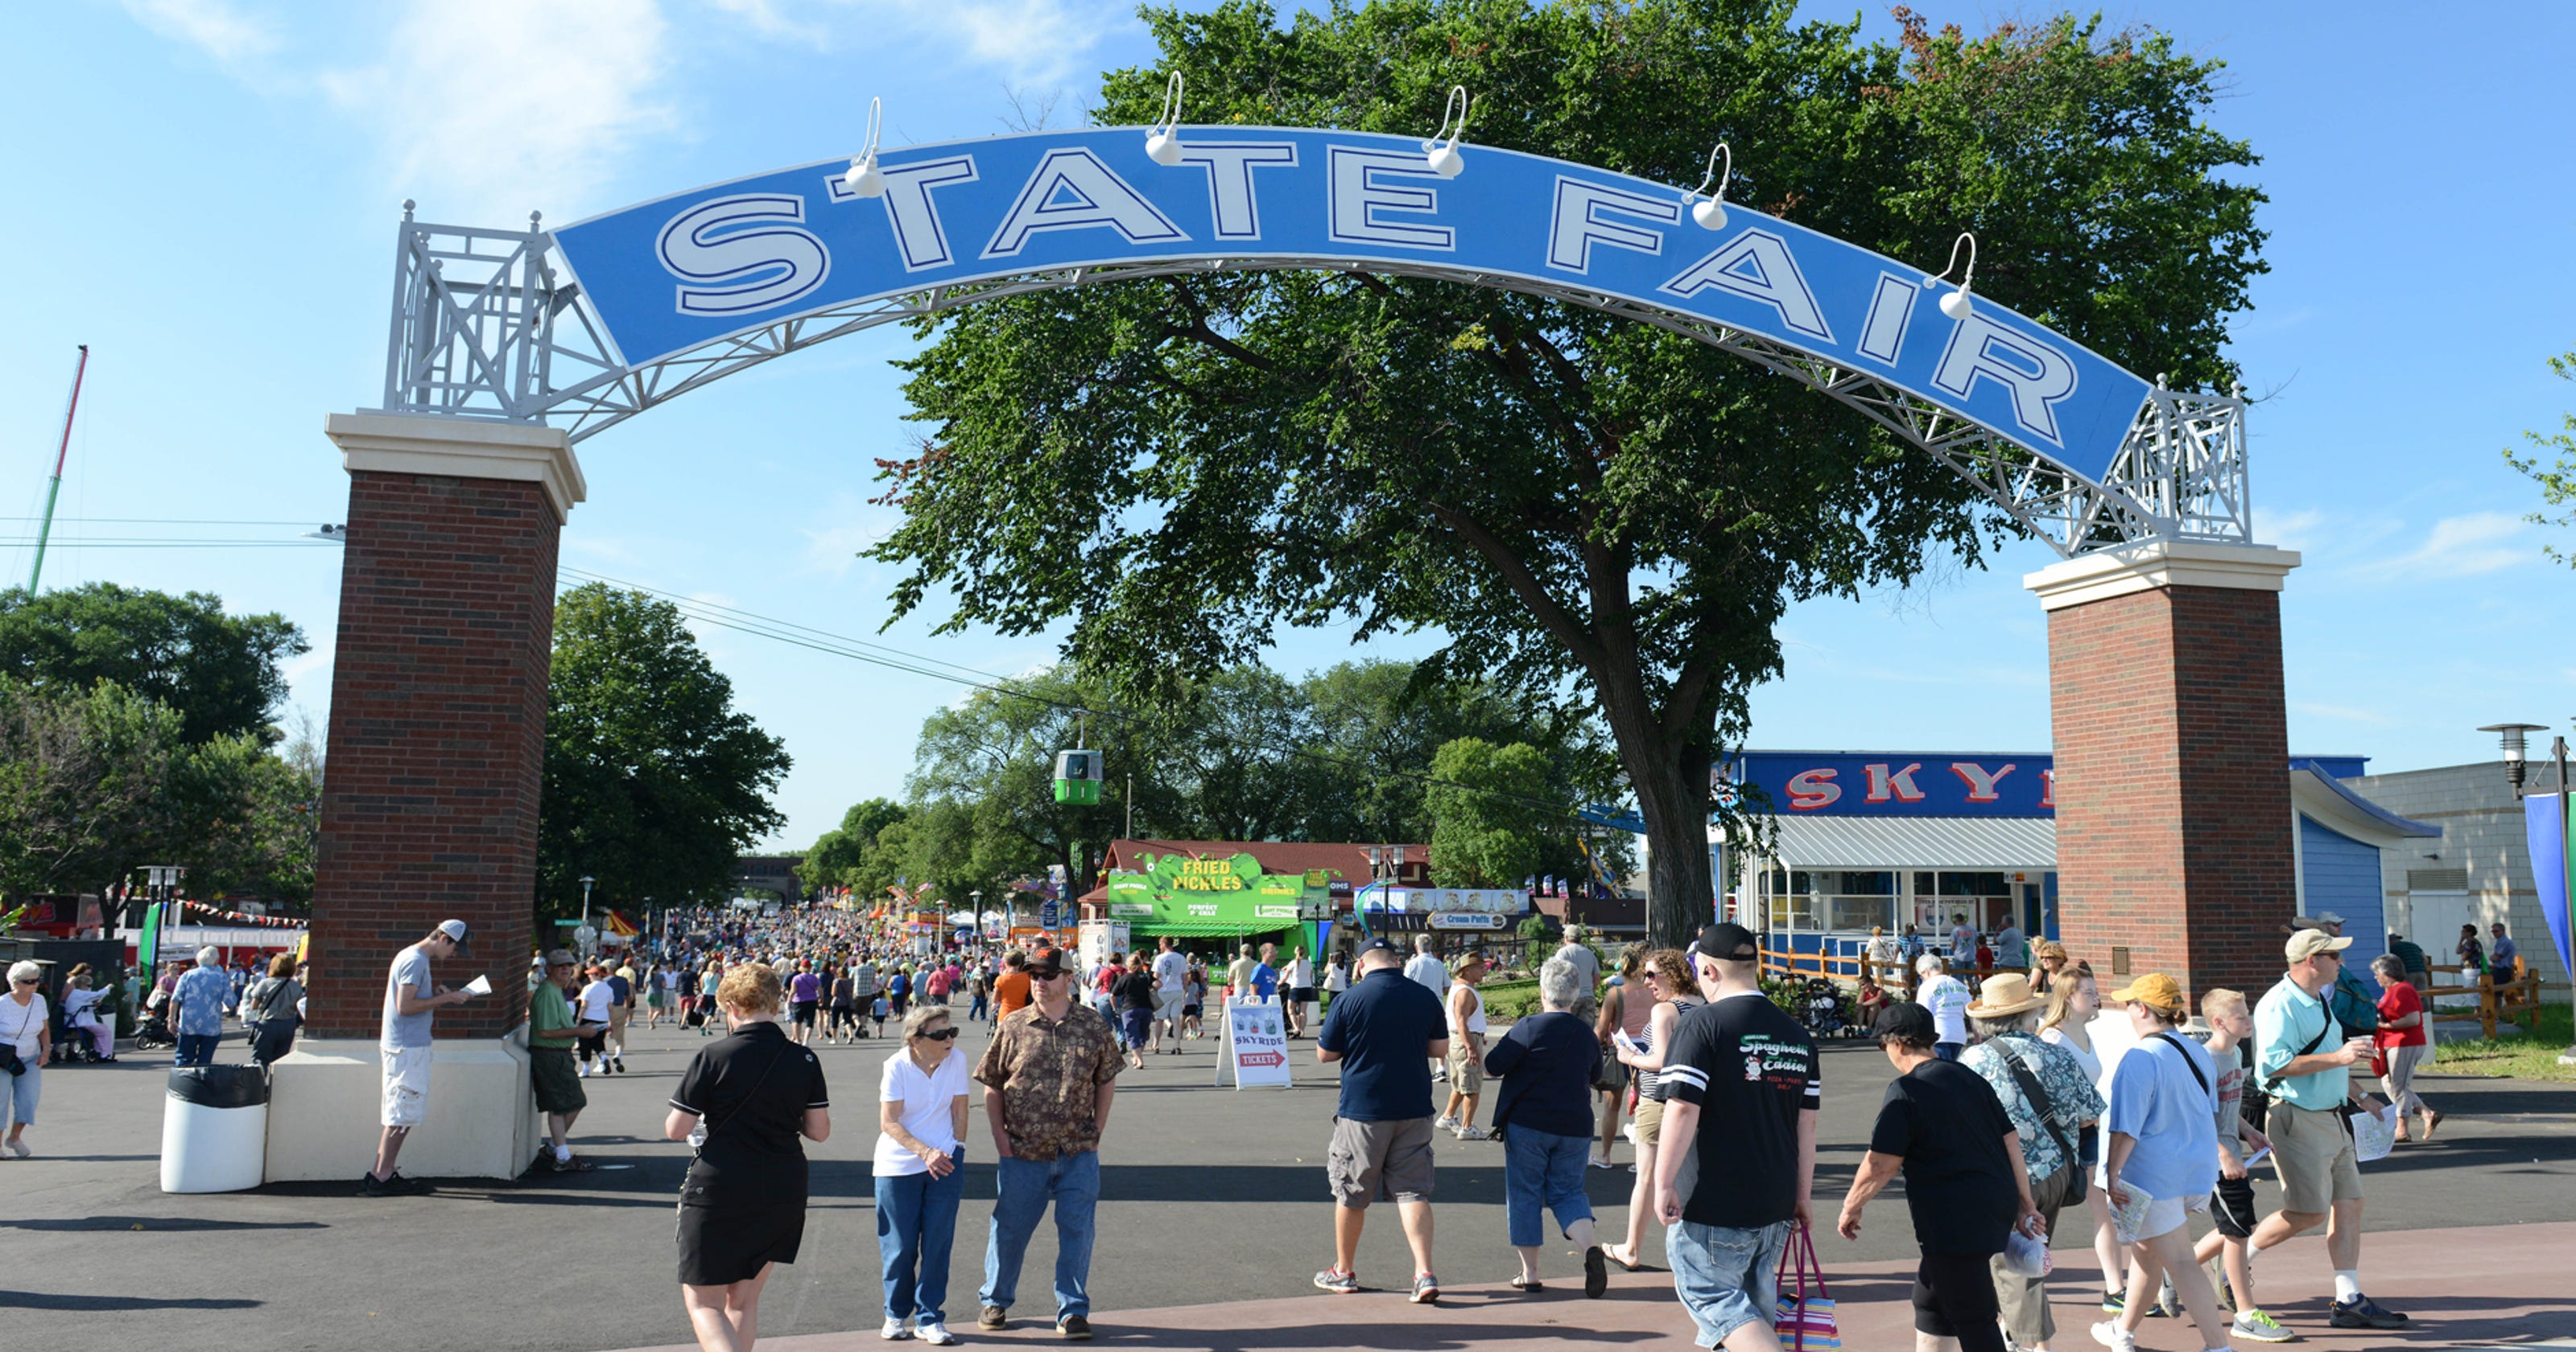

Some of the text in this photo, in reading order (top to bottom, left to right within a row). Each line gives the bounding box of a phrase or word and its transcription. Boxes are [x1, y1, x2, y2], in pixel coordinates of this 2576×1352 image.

[655, 140, 2079, 449] STATE FAIR
[1785, 763, 2054, 810] SKY
[1183, 860, 1231, 876] FRIED
[1173, 876, 1242, 891] PICKLES
[1261, 888, 1295, 896] DRINKS
[1187, 903, 1219, 911] PERFECT
[1447, 914, 1469, 923] Cream
[1235, 1036, 1284, 1046] SKYRIDE
[1739, 1034, 1809, 1057] Spaghetti
[1242, 1054, 1278, 1065] TICKETS
